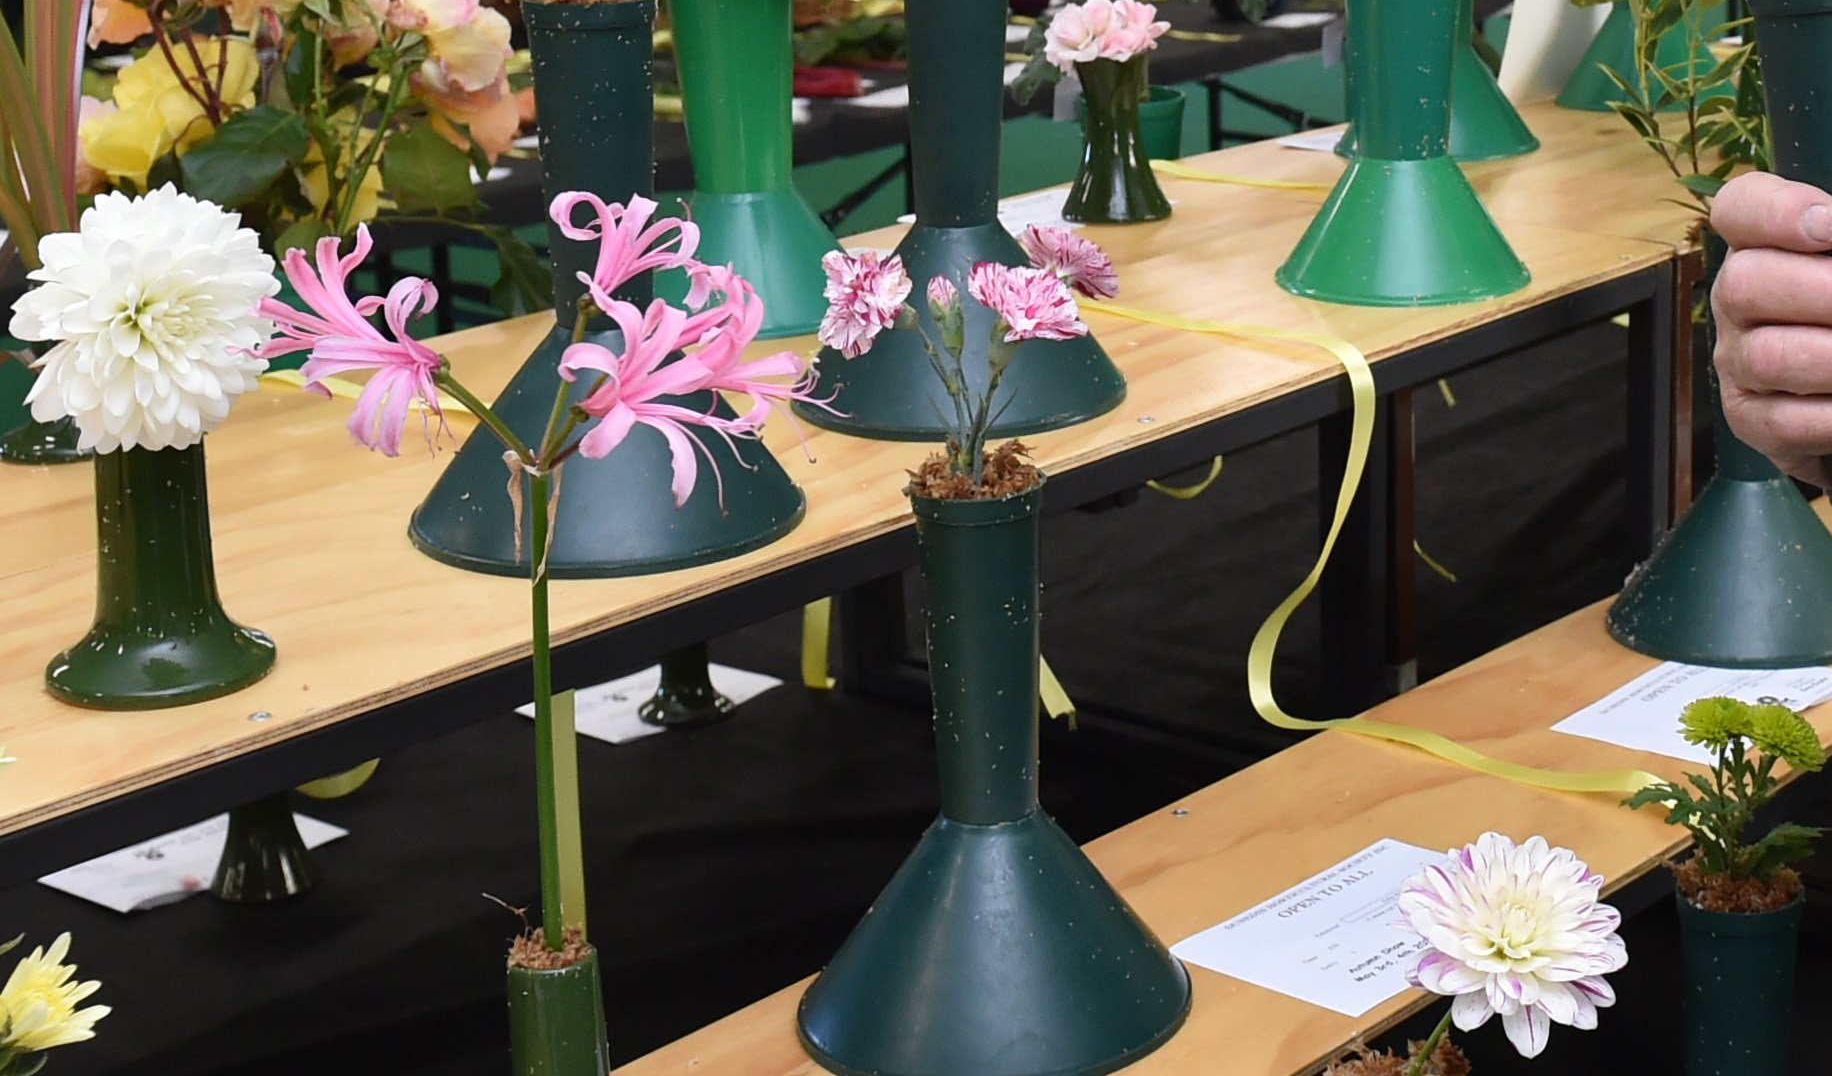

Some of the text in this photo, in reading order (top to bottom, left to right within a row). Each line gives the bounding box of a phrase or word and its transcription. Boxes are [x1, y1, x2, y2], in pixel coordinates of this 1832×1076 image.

[1277, 868, 1374, 920] OPEN TO ALL
[1348, 954, 1381, 974] Autumn
[1381, 940, 1406, 955] Show
[1353, 971, 1377, 982] May
